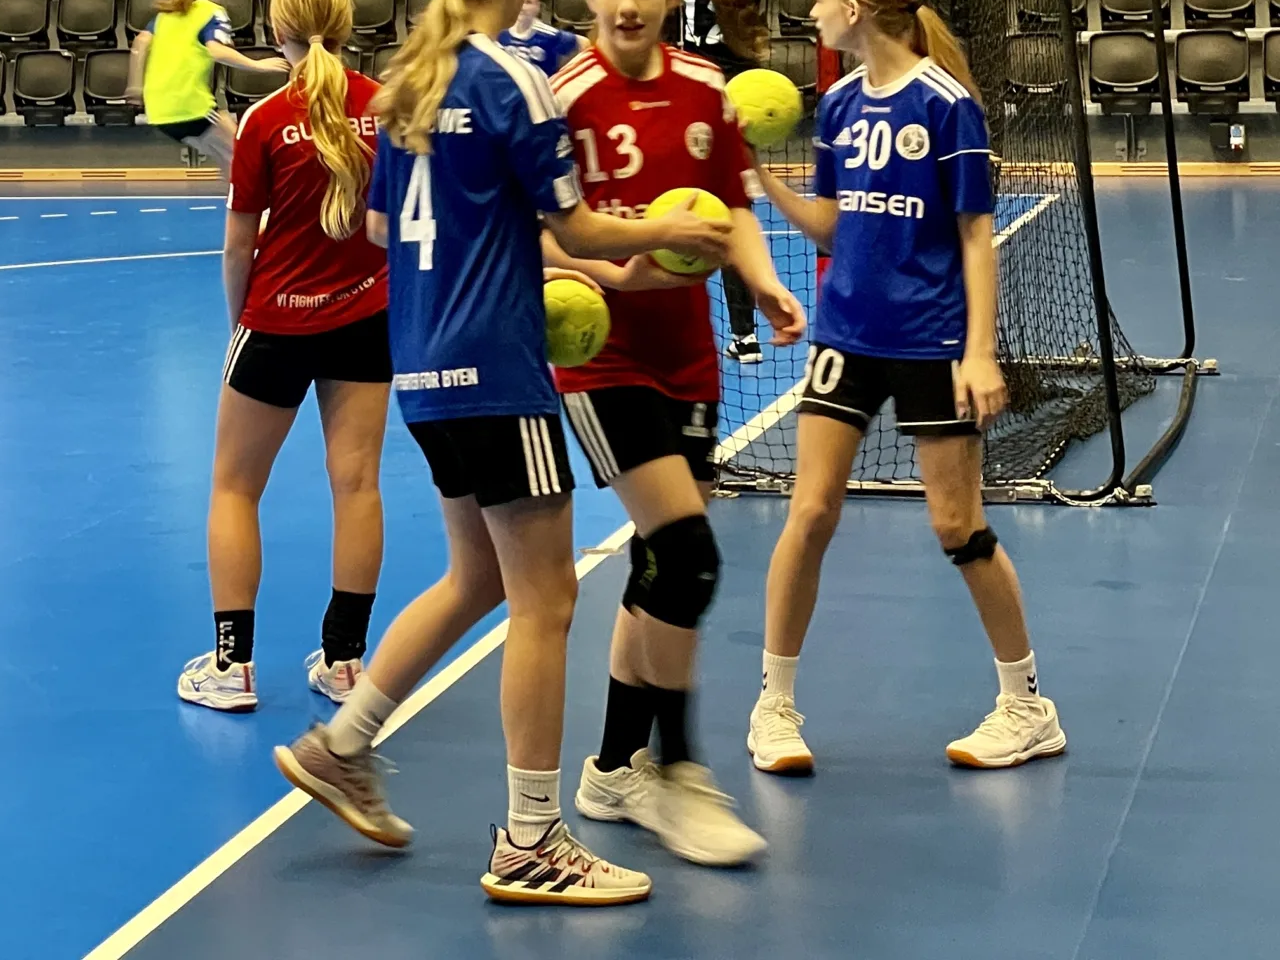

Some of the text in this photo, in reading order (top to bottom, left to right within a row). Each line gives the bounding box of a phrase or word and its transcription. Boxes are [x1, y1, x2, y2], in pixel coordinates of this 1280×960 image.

[575, 123, 645, 183] 13
[845, 118, 892, 171] 30
[400, 156, 437, 271] 4
[837, 189, 925, 219] ansen
